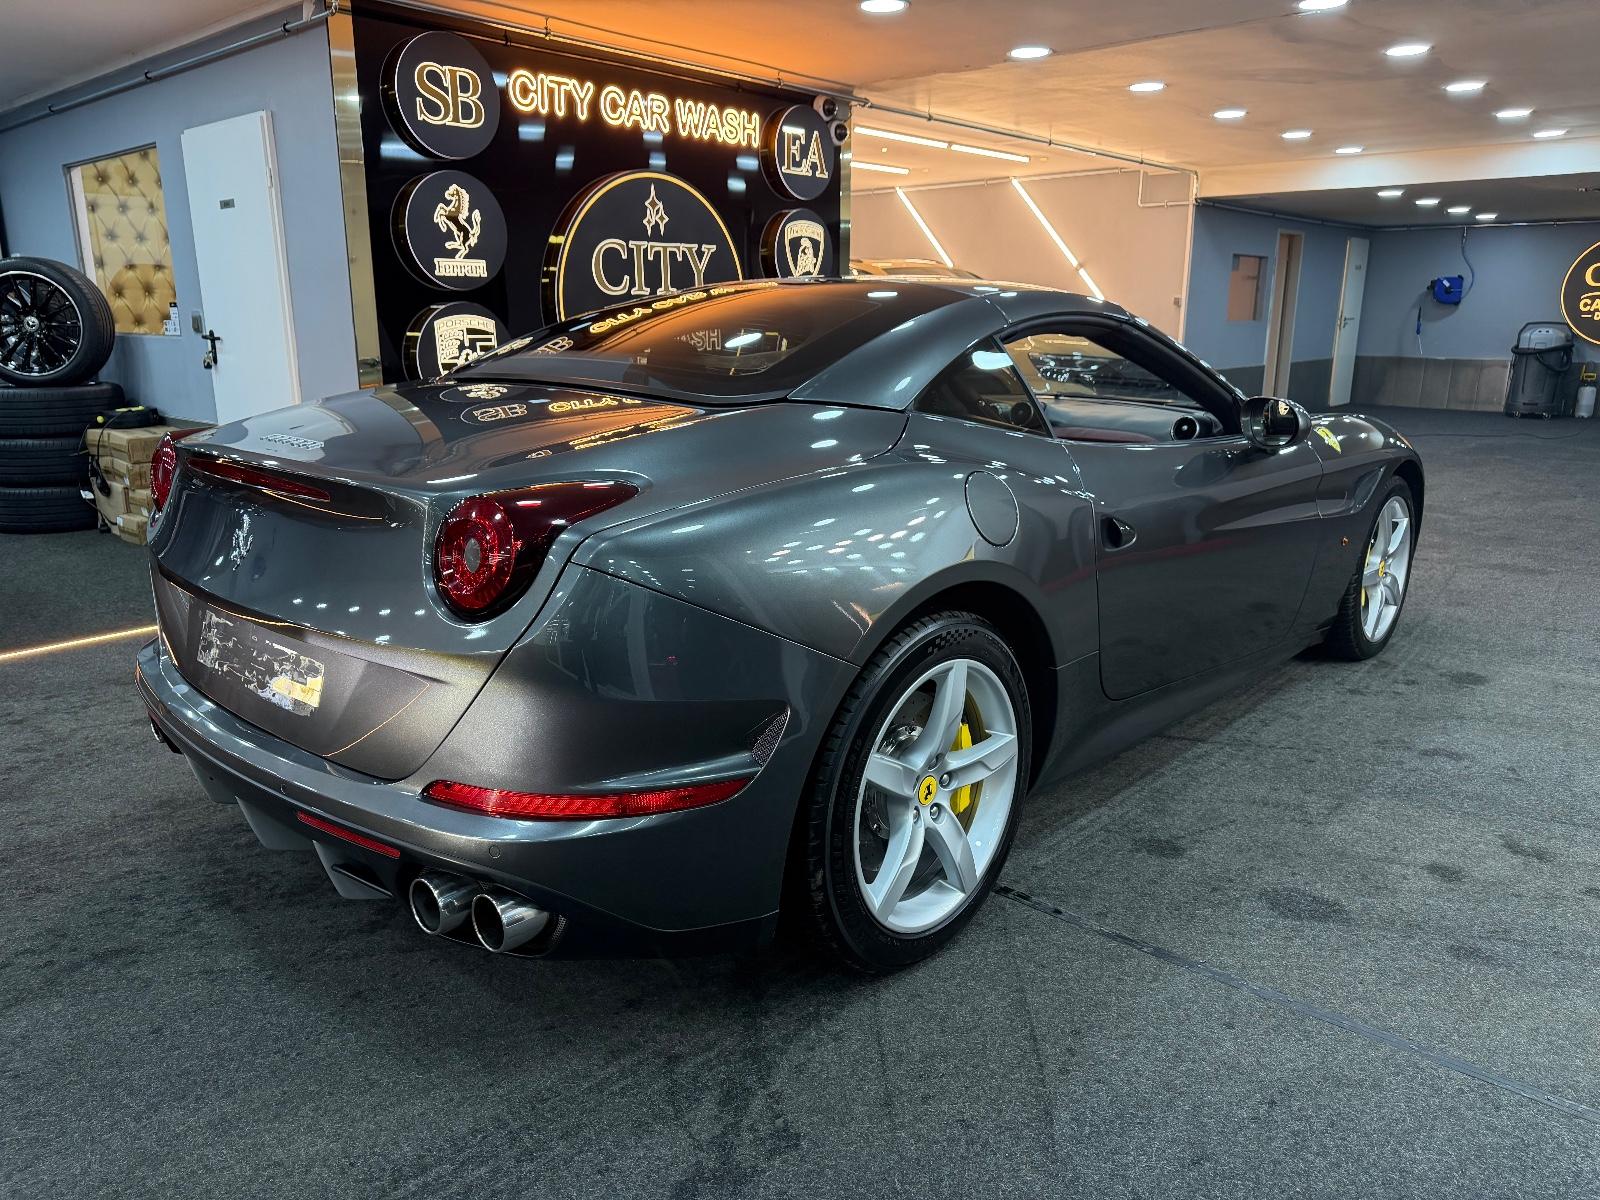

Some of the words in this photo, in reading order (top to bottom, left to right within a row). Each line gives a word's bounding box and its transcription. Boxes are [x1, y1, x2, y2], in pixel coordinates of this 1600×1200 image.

[414, 61, 486, 128] SB
[508, 69, 594, 119] CITY
[599, 85, 670, 132] CAR
[675, 98, 760, 147] WASH
[782, 130, 828, 178] EA
[591, 238, 717, 296] CITY
[438, 318, 495, 331] PORSCHE
